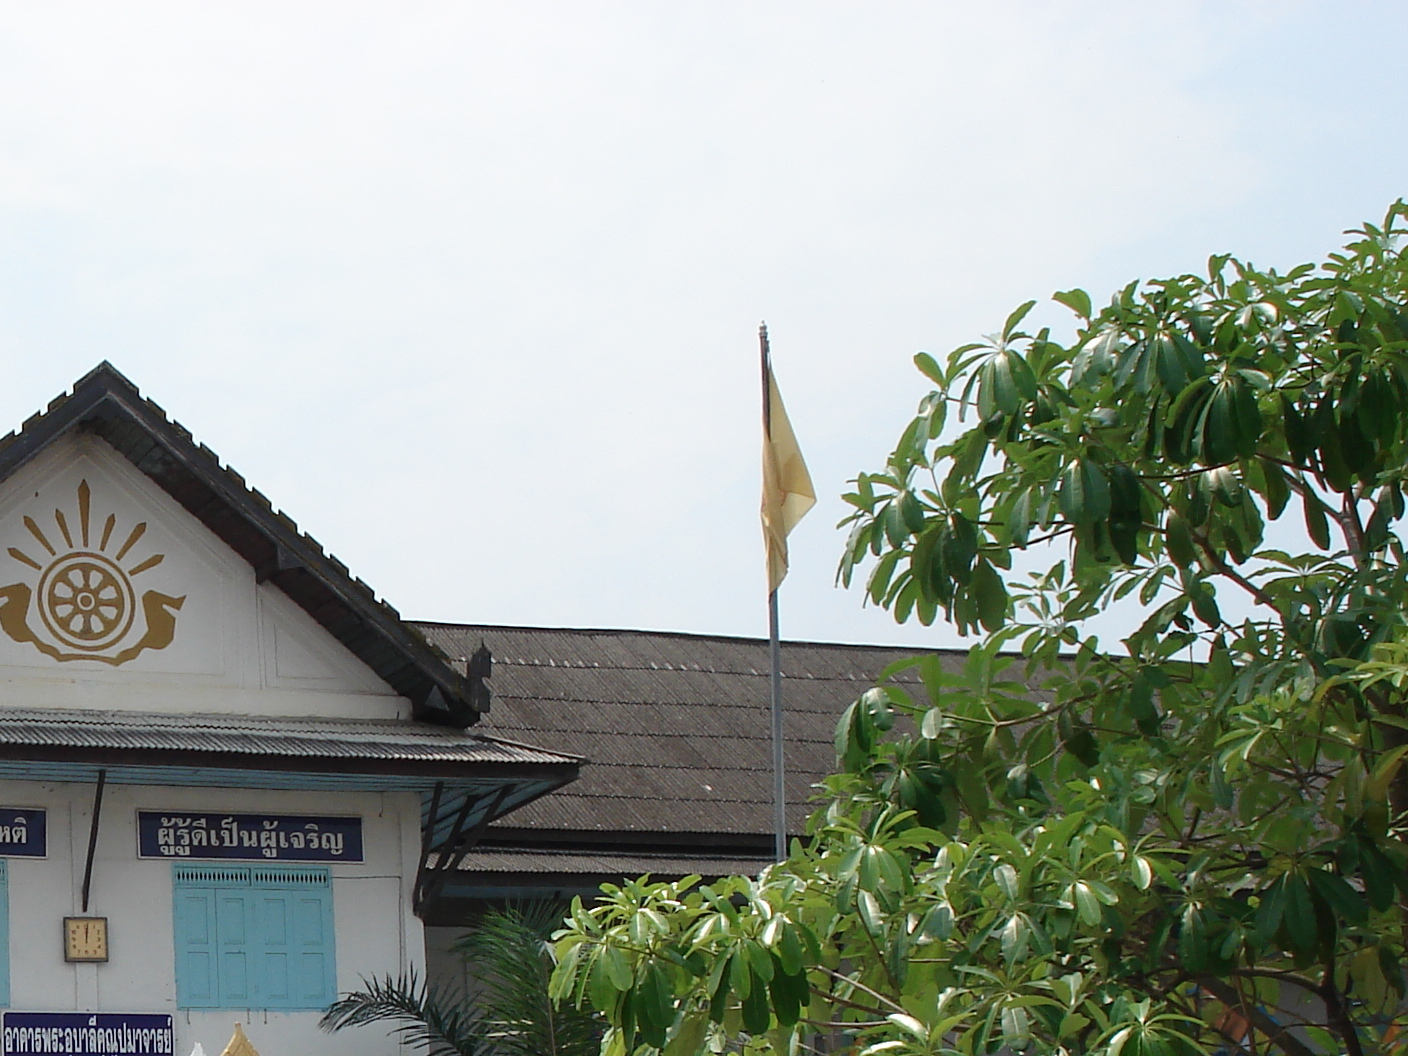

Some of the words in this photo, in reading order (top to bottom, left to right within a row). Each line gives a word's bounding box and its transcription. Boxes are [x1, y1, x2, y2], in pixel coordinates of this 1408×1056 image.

[157, 816, 344, 858] ผู้รู้ดีเป็นผู้เจริญ
